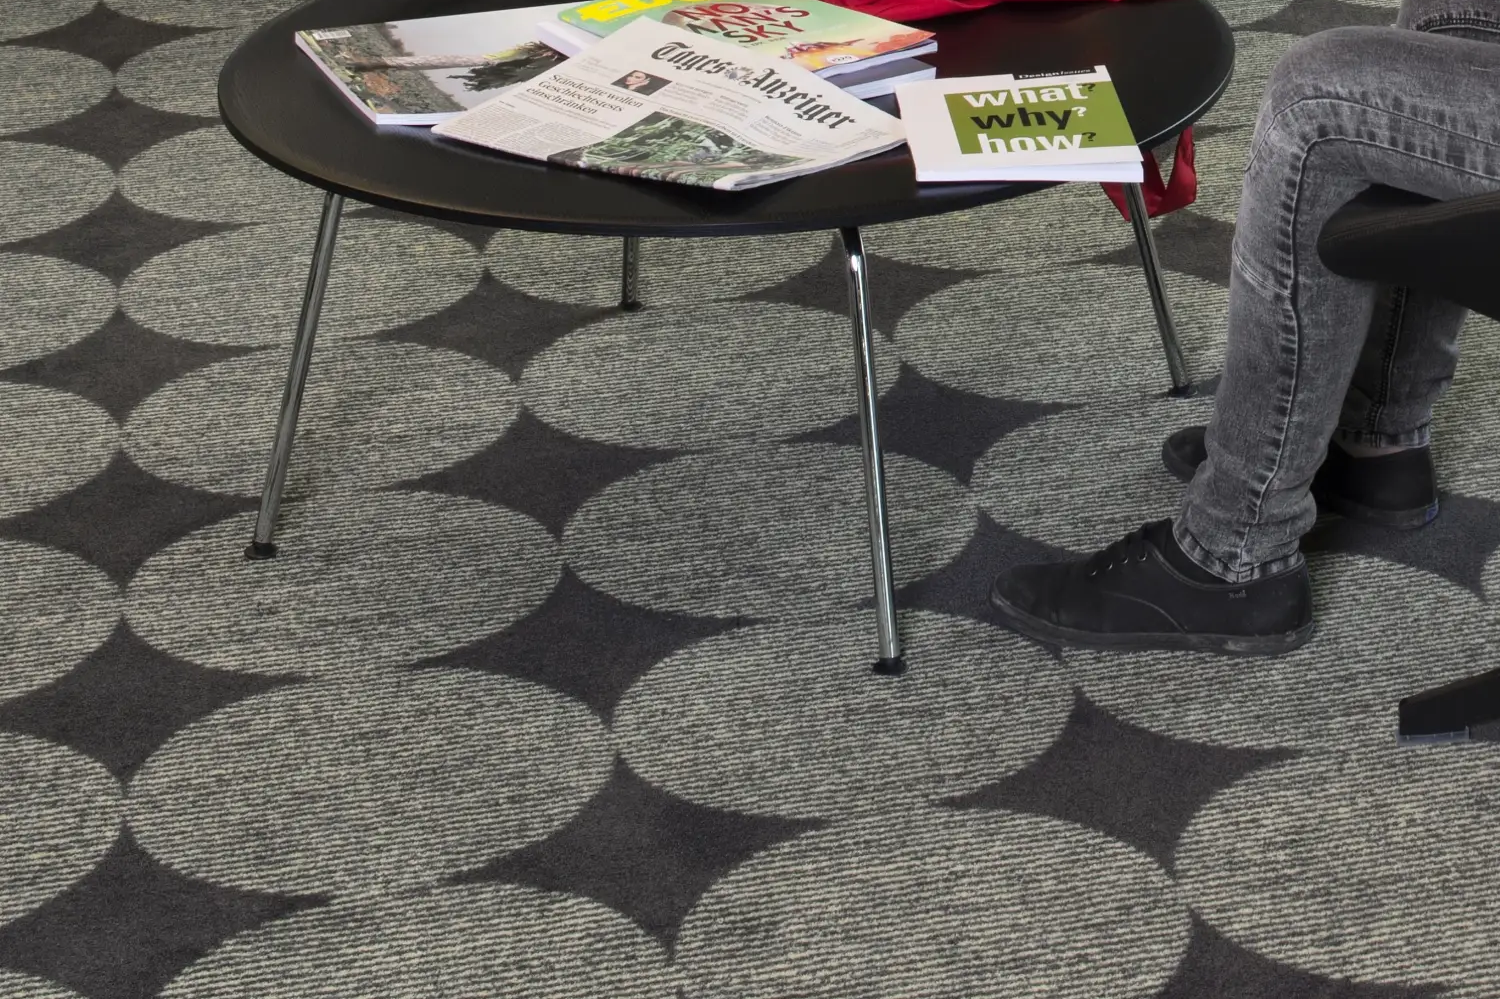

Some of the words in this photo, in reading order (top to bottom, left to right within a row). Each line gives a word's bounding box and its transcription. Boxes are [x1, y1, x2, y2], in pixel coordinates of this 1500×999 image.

[672, 3, 749, 20] NO
[723, 20, 805, 43] SKY
[538, 81, 624, 113] Geschlechtstests
[548, 74, 608, 97] Ständeräte
[607, 92, 644, 108] wollen
[651, 41, 733, 74] Tages
[738, 67, 857, 129] Anzeiger
[963, 82, 1096, 108] what?
[526, 87, 598, 115] einschränken
[970, 106, 1087, 130] why?
[977, 132, 1096, 155] how?
